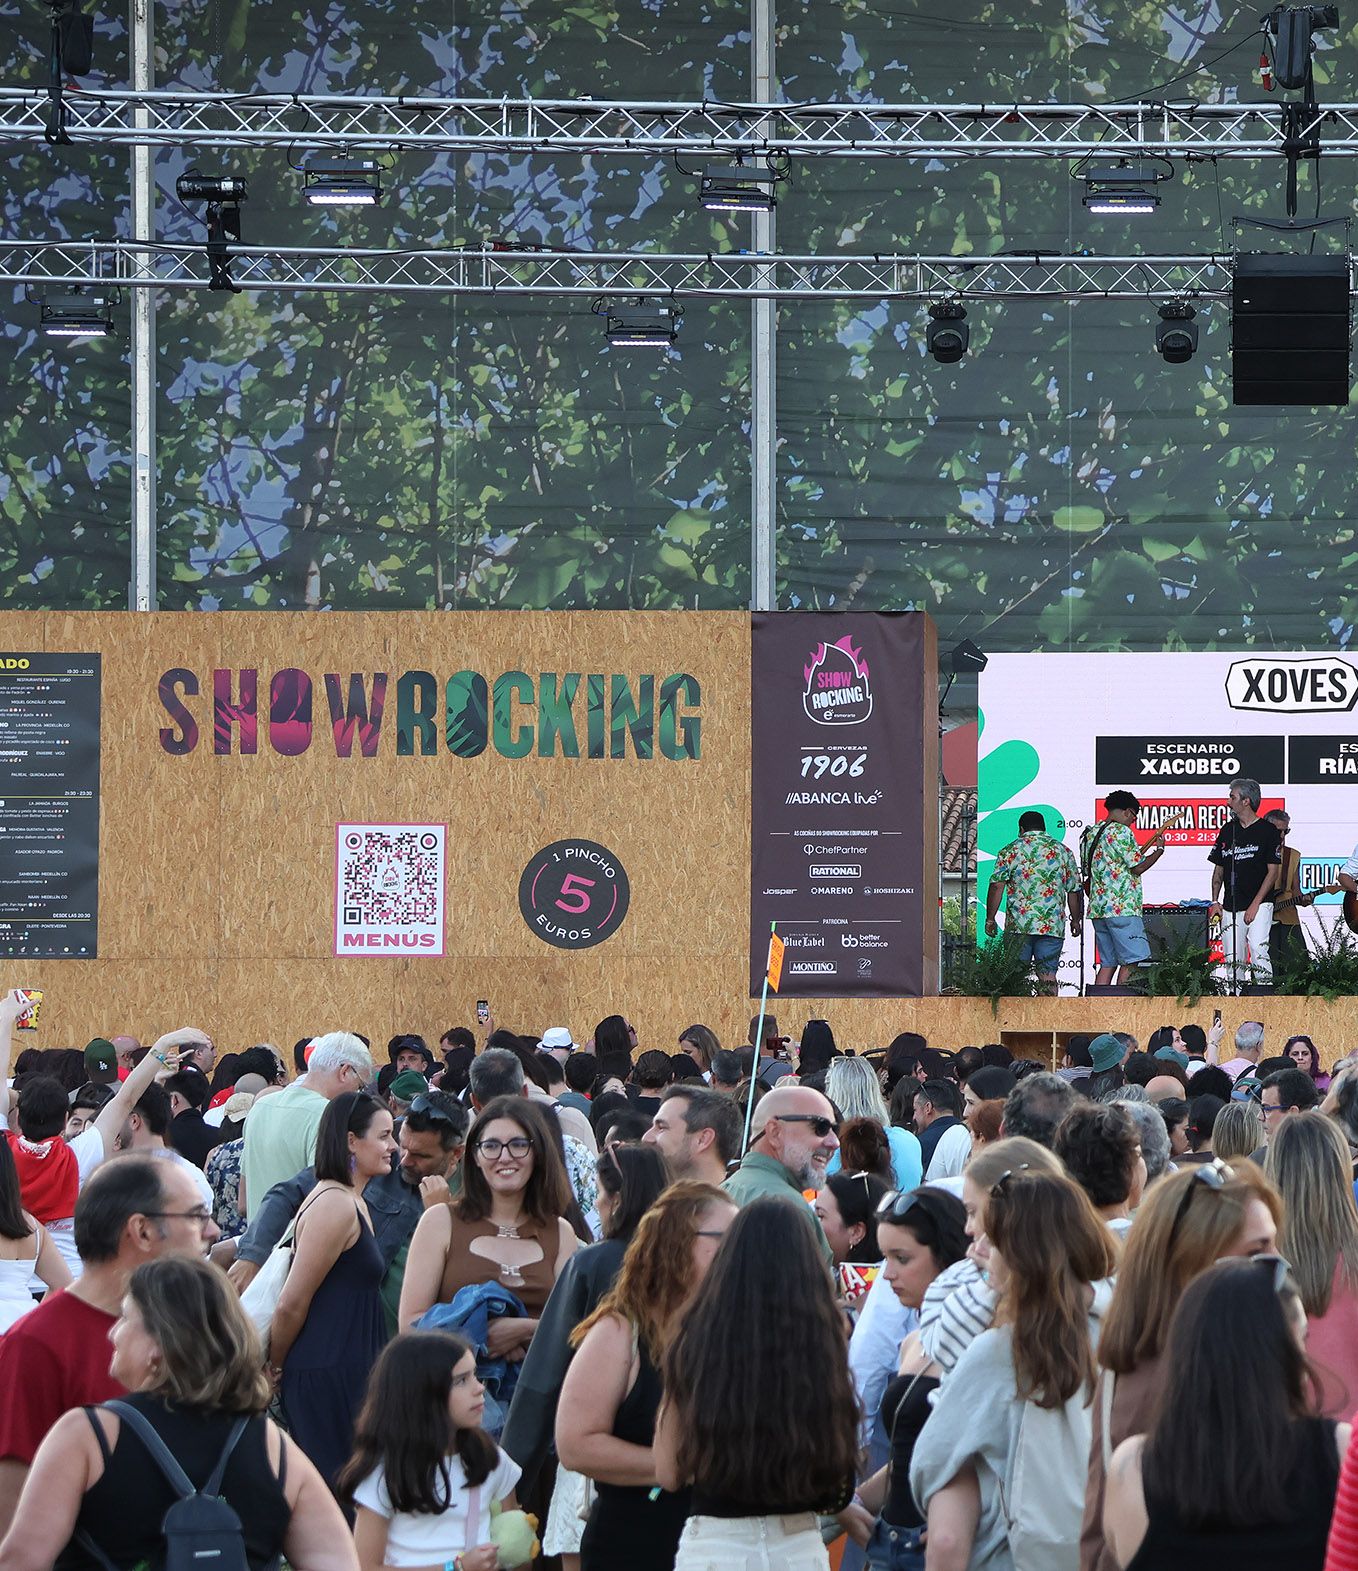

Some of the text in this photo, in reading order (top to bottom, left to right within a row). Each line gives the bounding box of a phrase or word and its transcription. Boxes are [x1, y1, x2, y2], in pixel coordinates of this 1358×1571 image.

[818, 671, 852, 688] SHOW
[1242, 667, 1348, 703] XOVES
[812, 686, 863, 709] ROCKING
[1147, 744, 1235, 754] ESCENARIO
[801, 753, 867, 780] 1906
[1140, 758, 1241, 775] XACOBEO
[1057, 820, 1084, 829] 21:00
[1165, 833, 1220, 842] 0:30 21:3
[815, 846, 868, 854] ChefPartner
[552, 848, 616, 878] 1 PINCHO
[812, 867, 859, 875] RATIONAL
[555, 873, 597, 914] 5
[535, 913, 591, 940] EUROS
[343, 929, 436, 947] MENÚS
[782, 936, 825, 947] Blue Label
[792, 962, 834, 971] MONTIÑO
[1058, 960, 1083, 969] 0:00
